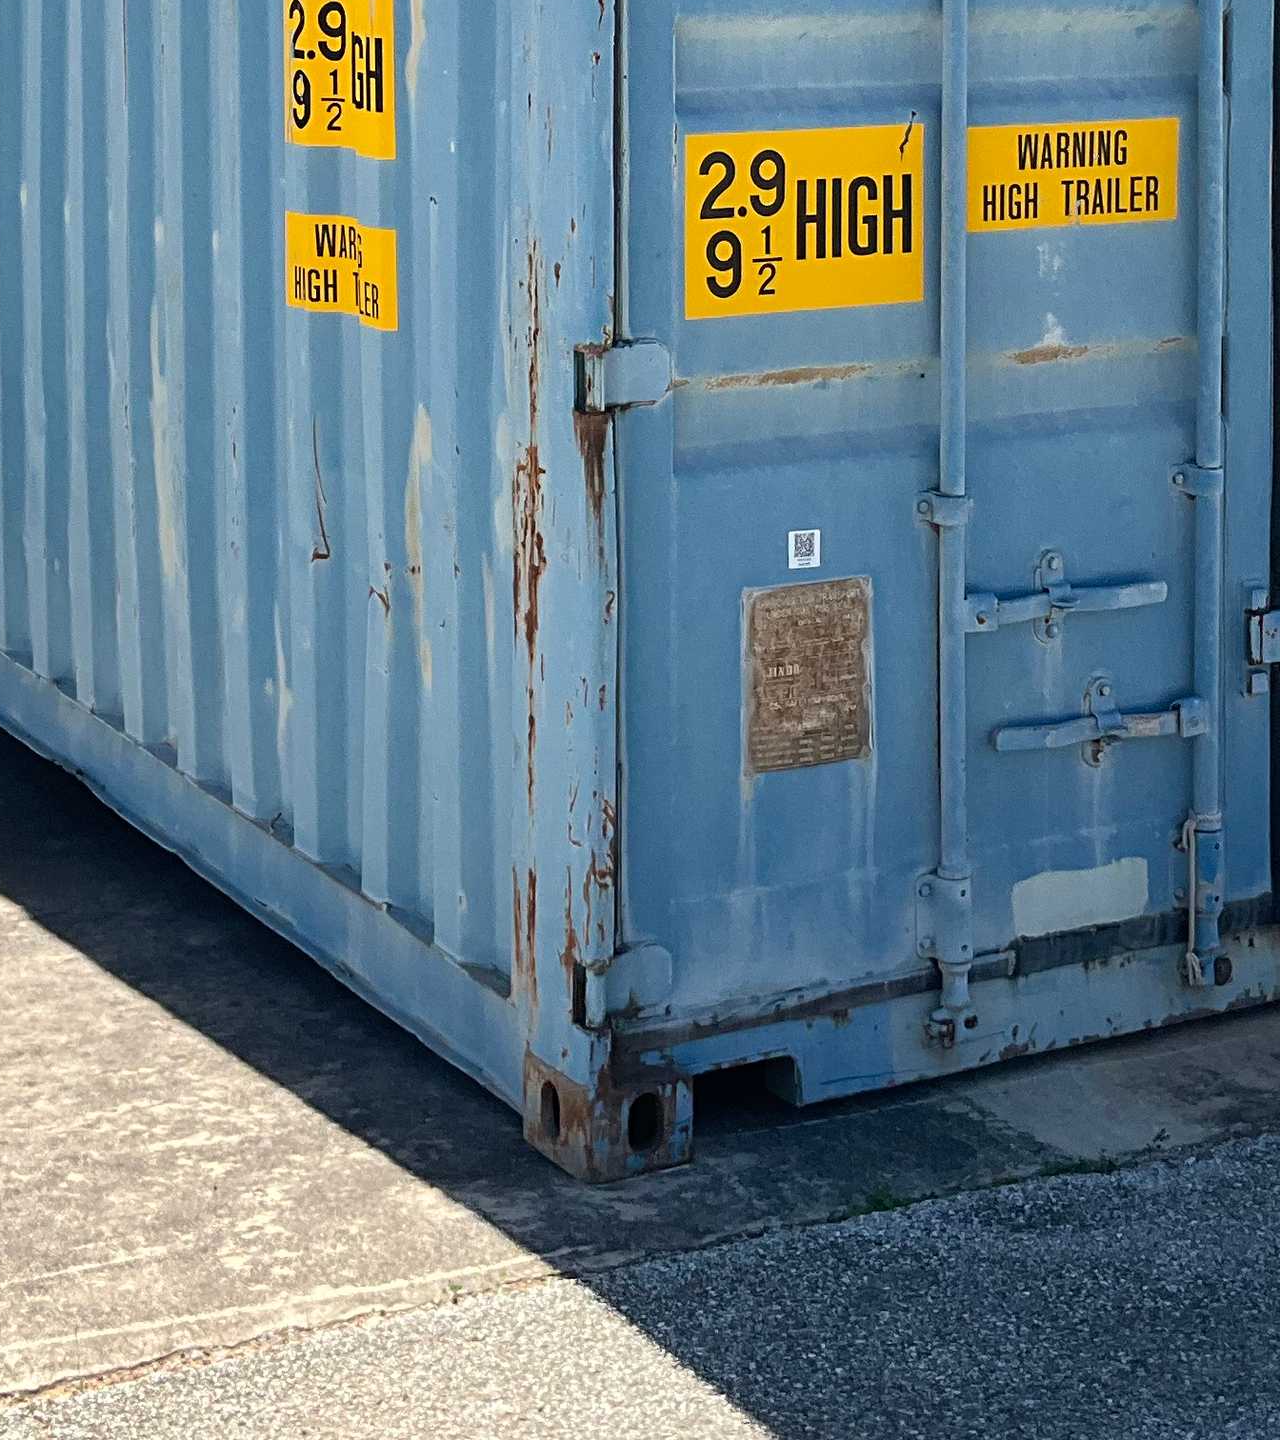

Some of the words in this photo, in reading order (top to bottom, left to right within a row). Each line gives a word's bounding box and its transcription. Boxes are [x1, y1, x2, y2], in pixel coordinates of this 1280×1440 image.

[289, 0, 346, 61] 2.9
[1017, 129, 1128, 170] WARNING
[698, 149, 786, 220] 2.9
[983, 183, 1038, 221] HIGH
[1061, 175, 1159, 217] TRAILER
[795, 173, 913, 261] HIGH
[294, 266, 338, 303] HIGH
